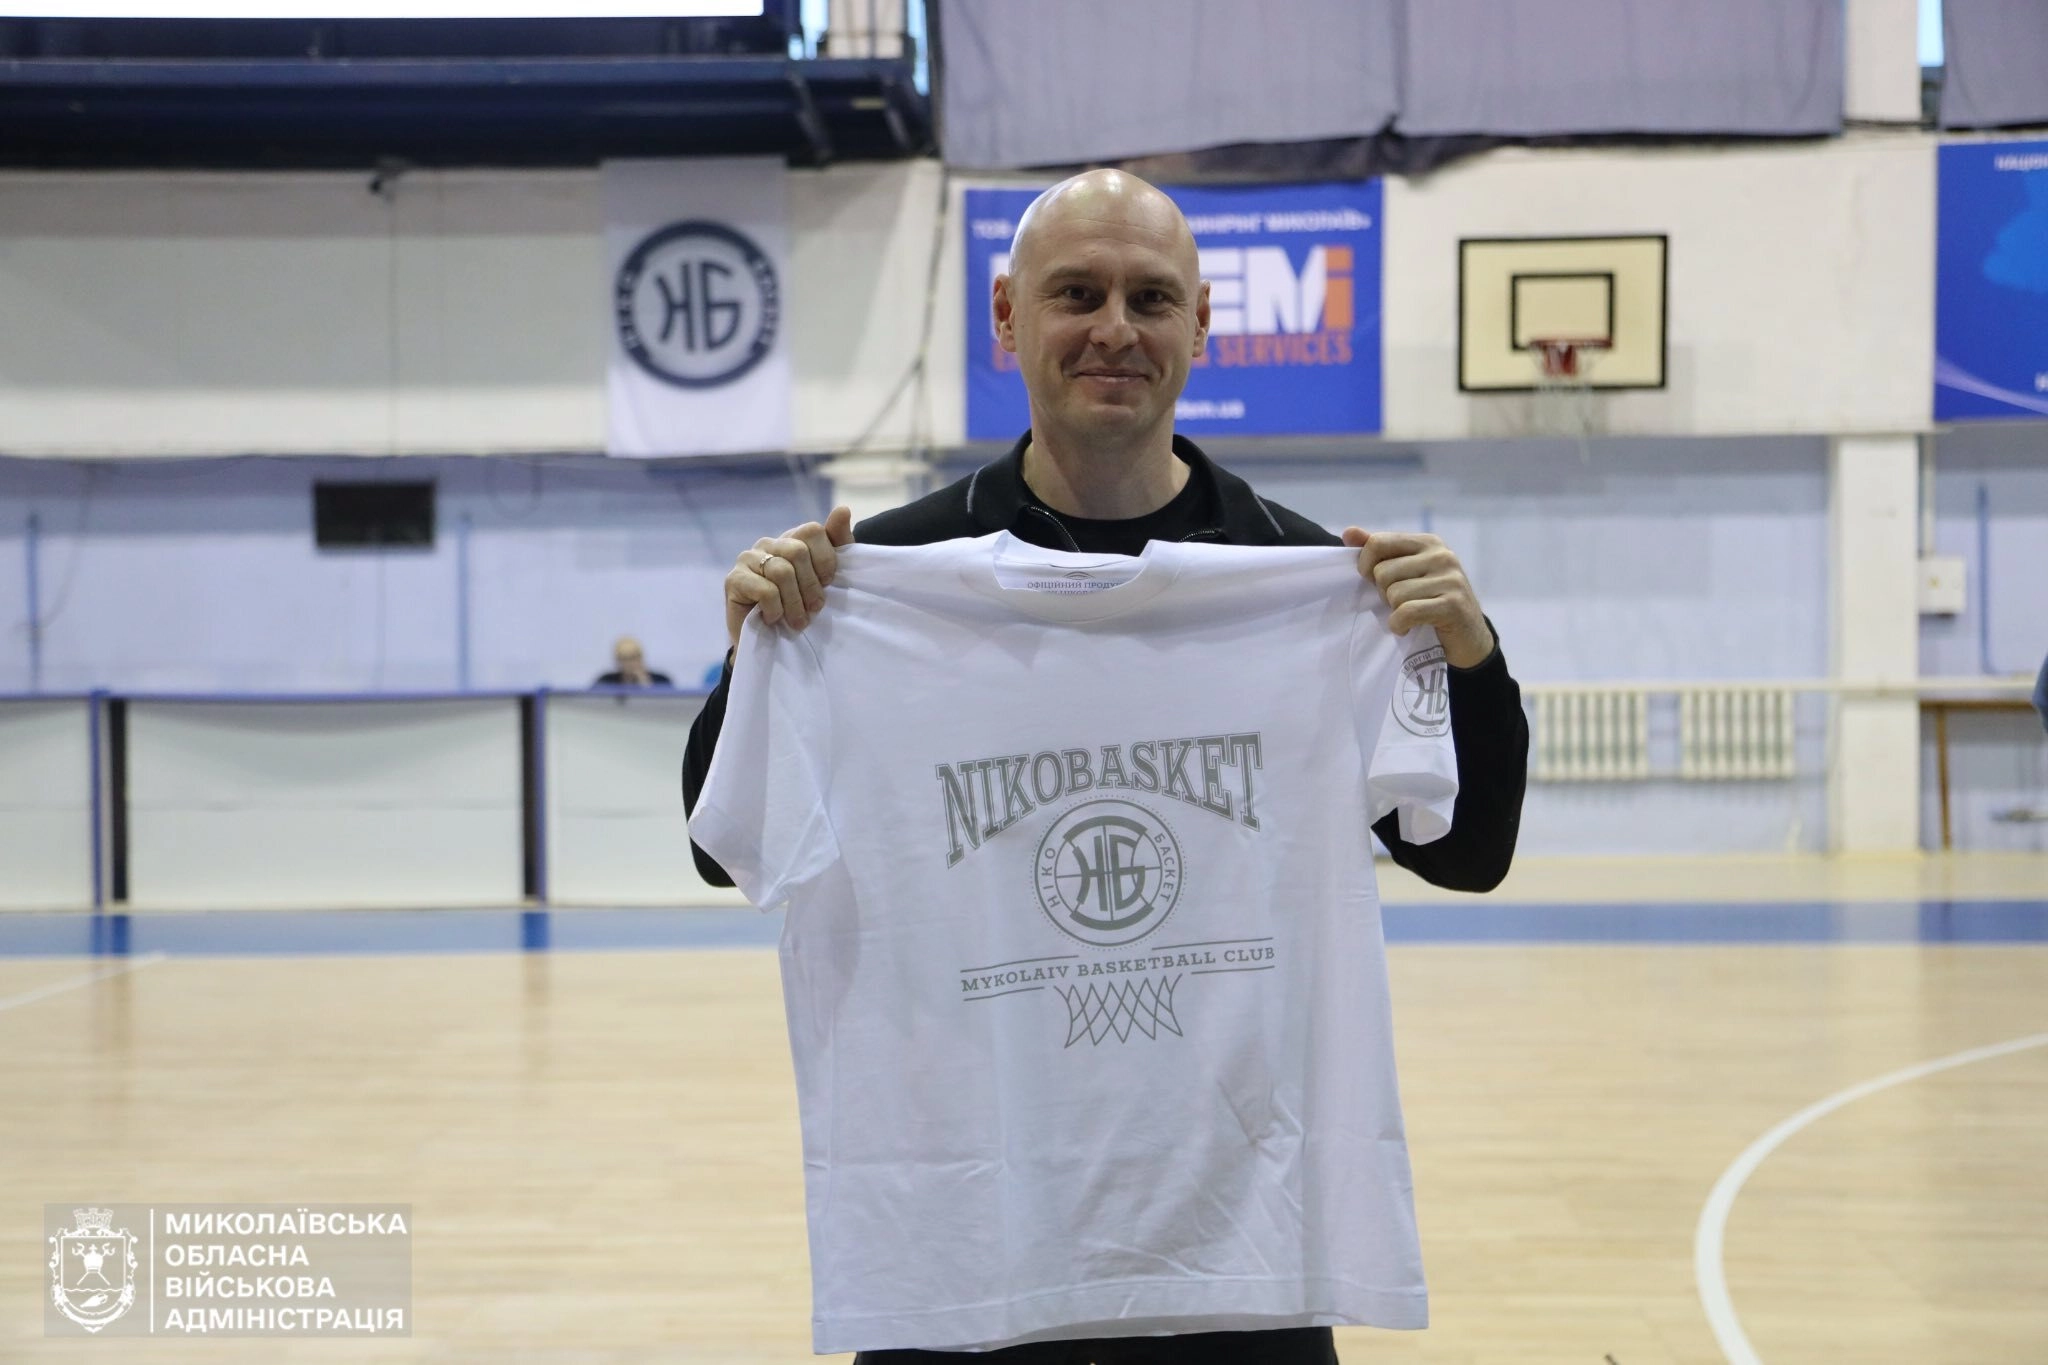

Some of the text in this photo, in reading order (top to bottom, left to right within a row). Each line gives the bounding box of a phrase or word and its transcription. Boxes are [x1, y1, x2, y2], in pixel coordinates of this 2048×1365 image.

[1215, 333, 1354, 369] SERVICES
[1027, 580, 1082, 590] ОФІЦІЙНИЙ
[935, 731, 1264, 869] NIKOBASKET
[1041, 847, 1061, 908] НІКО
[1154, 833, 1176, 902] БАСКЕТ
[961, 947, 1276, 993] MYKOLAIV BASKETBALL CLUB
